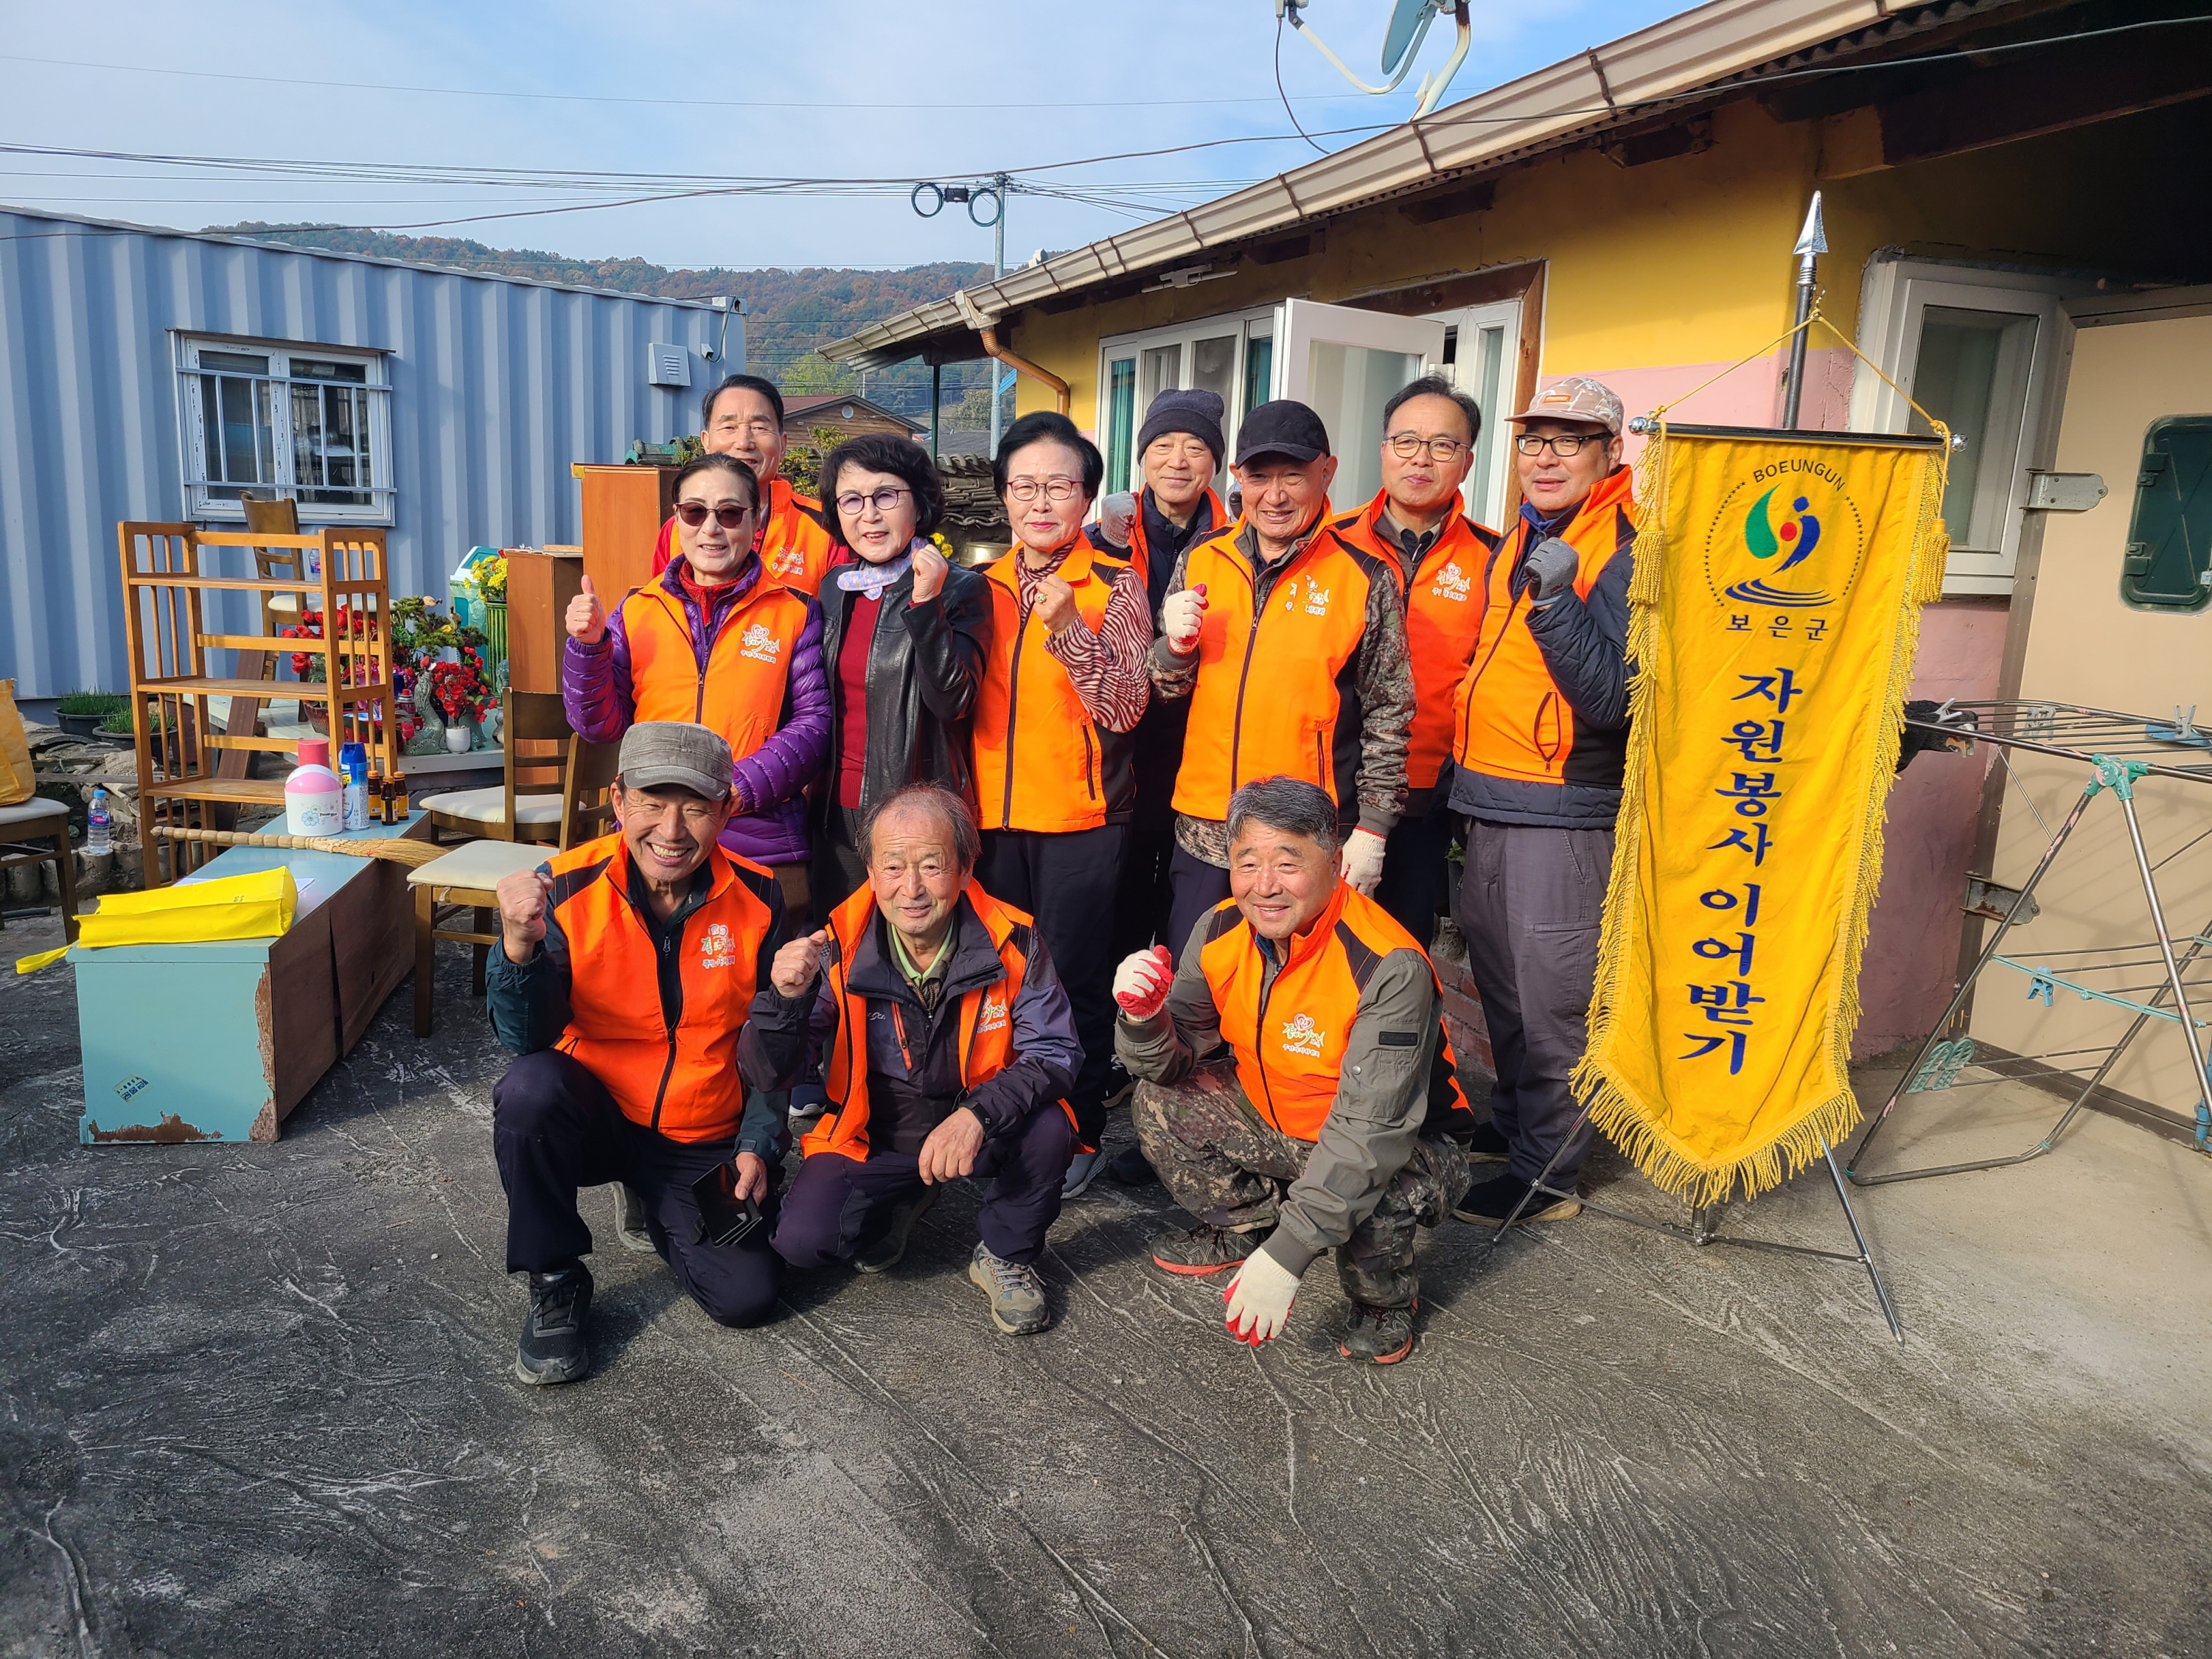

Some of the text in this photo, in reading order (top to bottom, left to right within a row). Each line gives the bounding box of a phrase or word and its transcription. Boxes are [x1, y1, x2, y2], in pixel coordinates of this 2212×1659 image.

[1753, 458, 1846, 492] BOEUNGUN
[1726, 615, 1828, 640] 보은군
[1677, 668, 1802, 1075] 자원봉사 이어받기
[977, 1019, 1007, 1033] 민자치위원회
